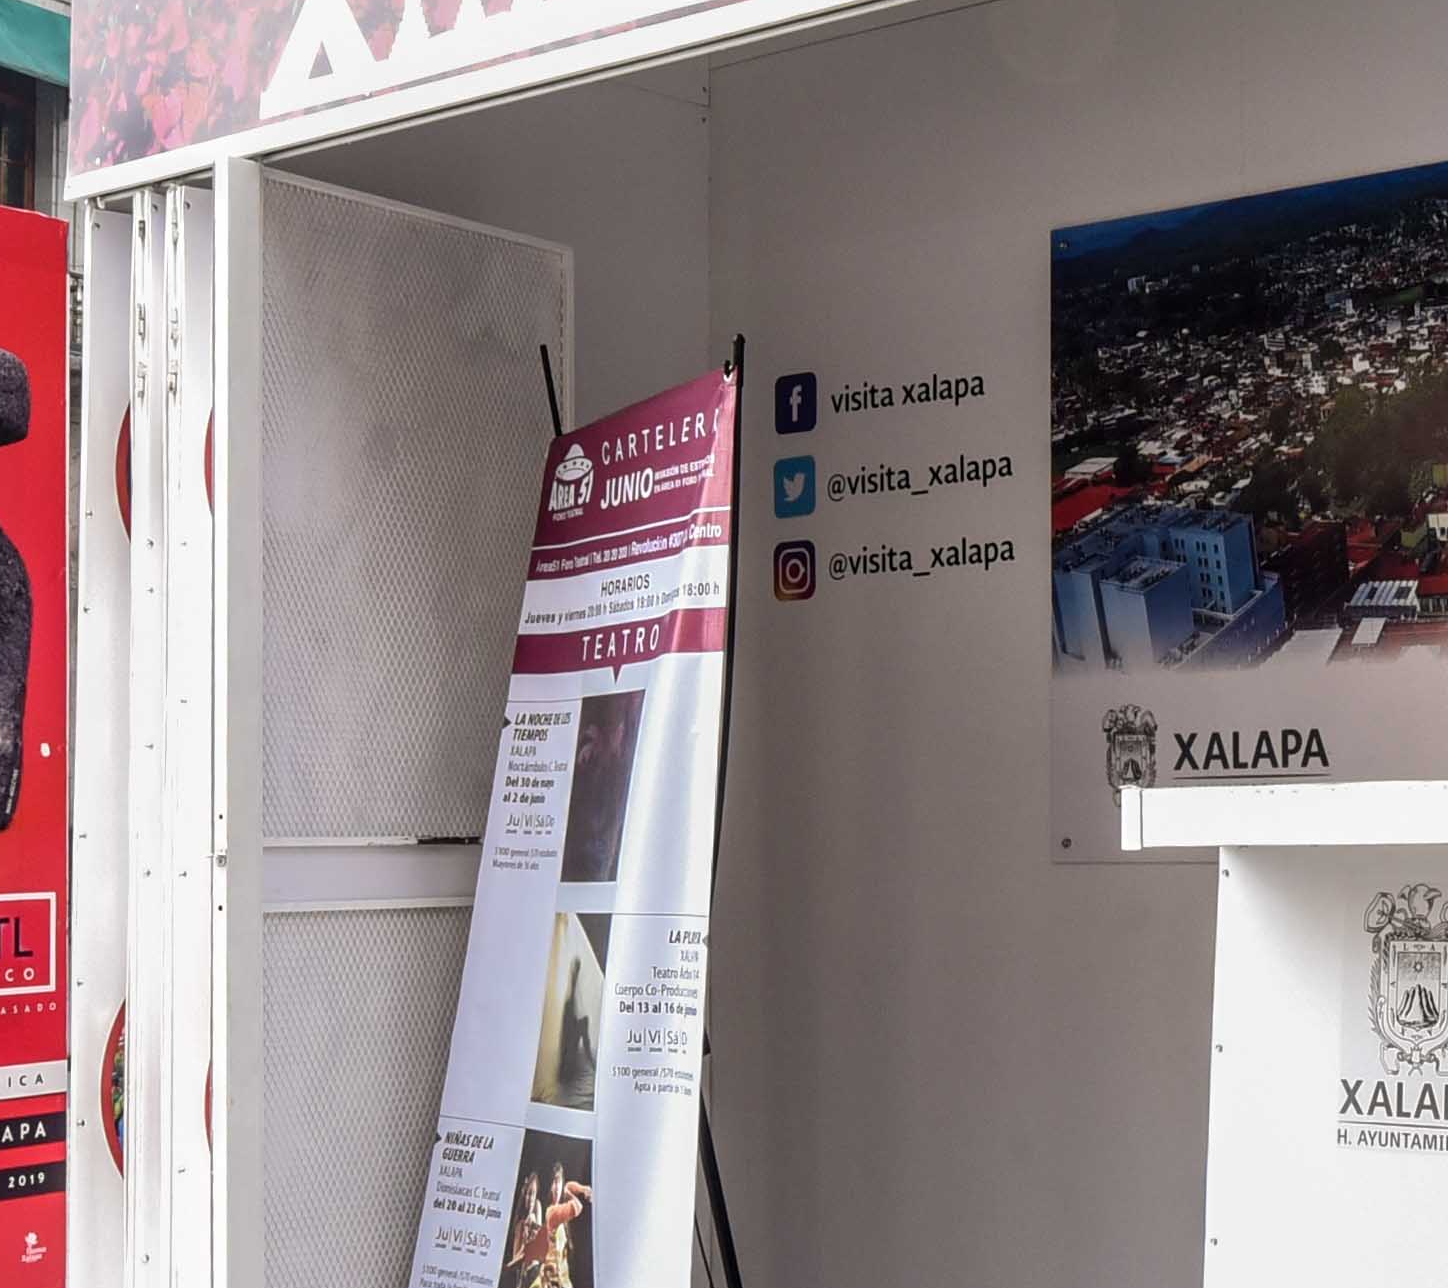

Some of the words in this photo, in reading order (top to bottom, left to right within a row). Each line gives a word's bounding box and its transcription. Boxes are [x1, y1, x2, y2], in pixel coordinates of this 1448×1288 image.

[831, 385, 894, 413] visita
[902, 374, 984, 406] xalapa
[827, 455, 1013, 501] @visita_xalapa
[600, 468, 653, 510] JUNIO
[689, 523, 721, 540] Centro
[829, 537, 1014, 580] @visita_xalapa
[601, 574, 650, 596] HORARIOS
[525, 613, 555, 625] Jueves
[558, 613, 562, 624] y
[713, 583, 719, 594] h
[582, 624, 660, 661] TEATRO
[515, 713, 527, 725] LA
[528, 712, 553, 726] NOCHE
[512, 728, 548, 742] TIEMPOS
[1173, 729, 1330, 770] XALAPA
[505, 776, 519, 788] Del
[520, 777, 530, 788] 30
[532, 777, 540, 788] de
[502, 792, 510, 803] al
[512, 792, 519, 803] 2
[519, 792, 529, 804] de
[669, 930, 681, 944] LA
[653, 967, 678, 979] Teatro
[615, 983, 643, 999] Cuerpo
[619, 1001, 634, 1014] Del
[637, 1002, 650, 1014] 13
[652, 1001, 662, 1014] al
[664, 1002, 674, 1015] 16
[445, 1131, 472, 1147] NIÑAS
[472, 1136, 482, 1149] DE
[483, 1136, 495, 1151] LA
[1336, 1128, 1352, 1146] H.
[442, 1148, 475, 1164] GUERRA
[7, 1171, 47, 1190] 2019
[433, 1198, 446, 1210] del
[446, 1199, 458, 1211] 20
[458, 1200, 467, 1212] al
[466, 1202, 477, 1215] 23
[477, 1205, 486, 1217] de
